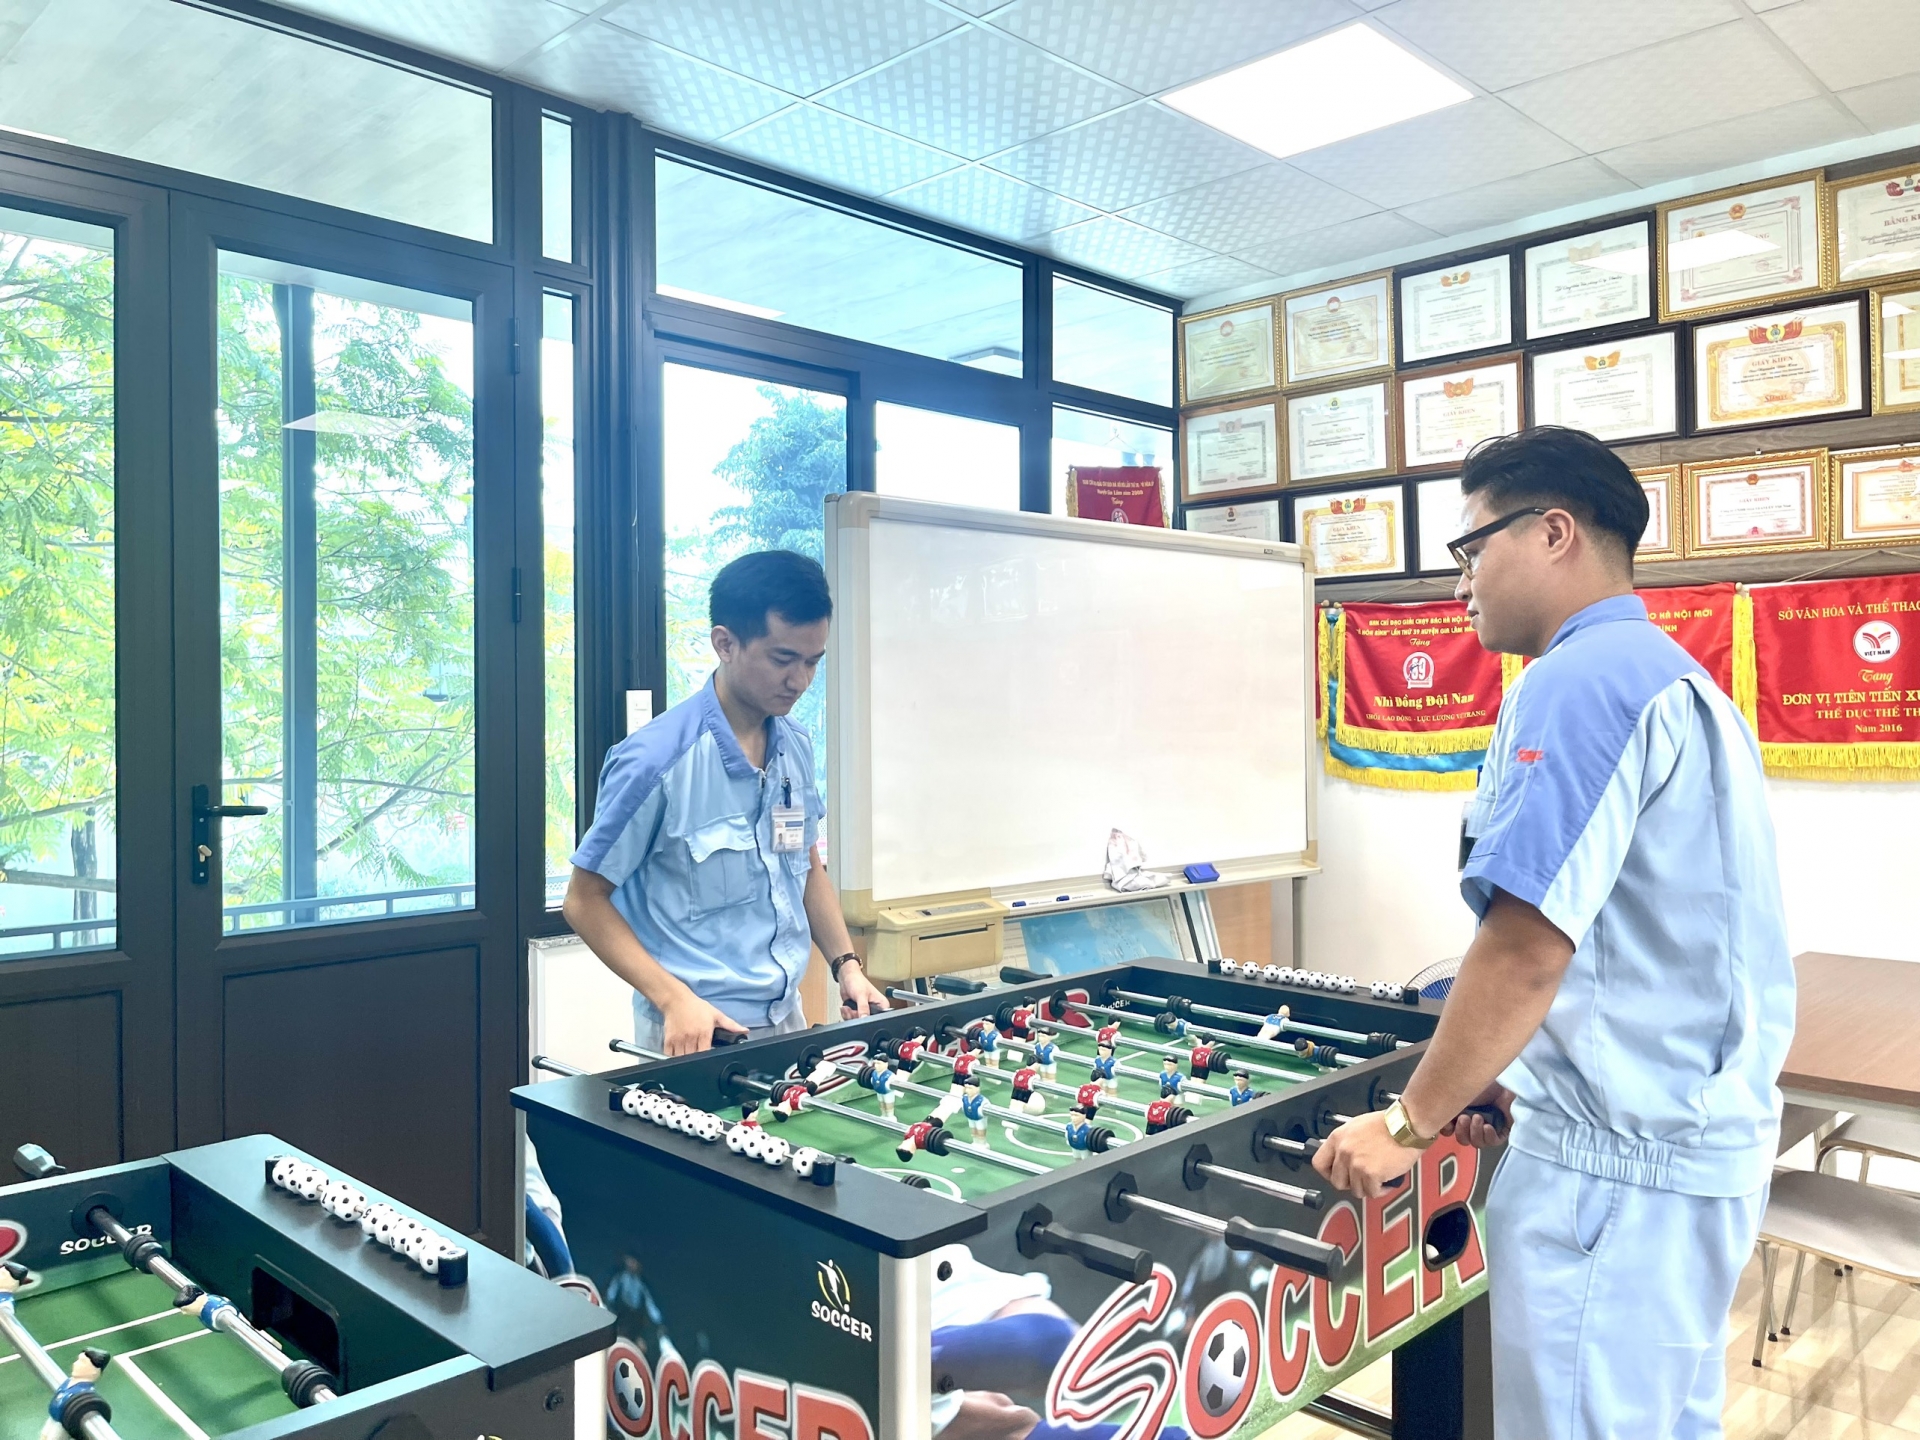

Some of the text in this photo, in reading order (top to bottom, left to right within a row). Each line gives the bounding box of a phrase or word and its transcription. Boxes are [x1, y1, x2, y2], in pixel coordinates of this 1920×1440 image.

[1659, 610, 1671, 619] HÀ
[1674, 609, 1691, 621] NỘI
[1694, 608, 1713, 618] MỚI
[1778, 607, 1793, 621] SỞ
[1847, 602, 1863, 615] VÀ
[1866, 598, 1889, 614] THỂ
[1660, 624, 1678, 632] ÌNH
[1426, 693, 1448, 708] Đội
[1782, 693, 1812, 705] ĐƠN
[1815, 693, 1831, 707] VỊ
[1834, 689, 1866, 703] TIÊN
[1869, 686, 1902, 703] TIẾN
[1815, 706, 1842, 719] THỂ
[1845, 709, 1872, 720] DỤC
[1874, 704, 1900, 718] THỂ
[1879, 724, 1903, 733] 2016
[60, 1224, 153, 1256] SOCR
[1046, 1133, 1488, 1440] SOCCER
[811, 1300, 872, 1342] SOCCER
